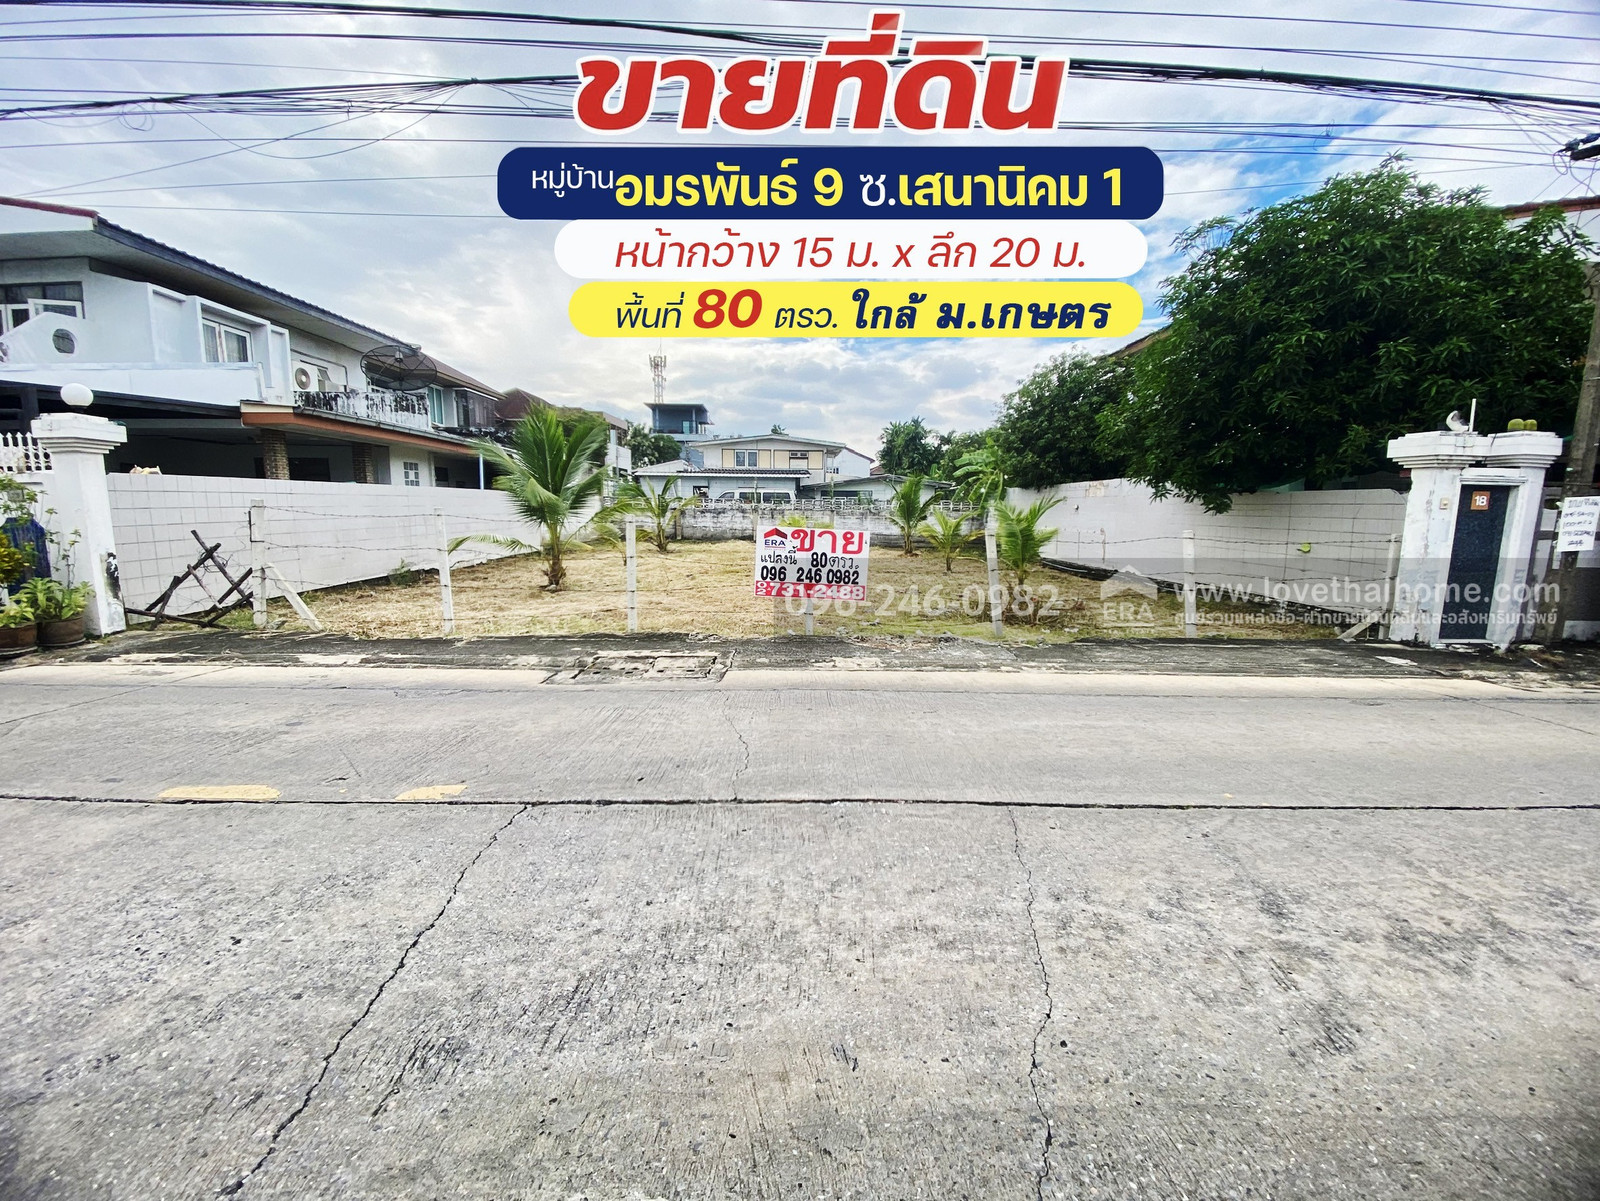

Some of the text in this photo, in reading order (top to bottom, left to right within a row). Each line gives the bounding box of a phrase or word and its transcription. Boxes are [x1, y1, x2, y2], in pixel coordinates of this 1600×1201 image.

[1474, 495, 1488, 506] 18
[764, 539, 786, 547] ERA
[790, 528, 864, 555] ขาย
[760, 545, 798, 566] แปลงนี้
[760, 565, 860, 586] 096 246 0982
